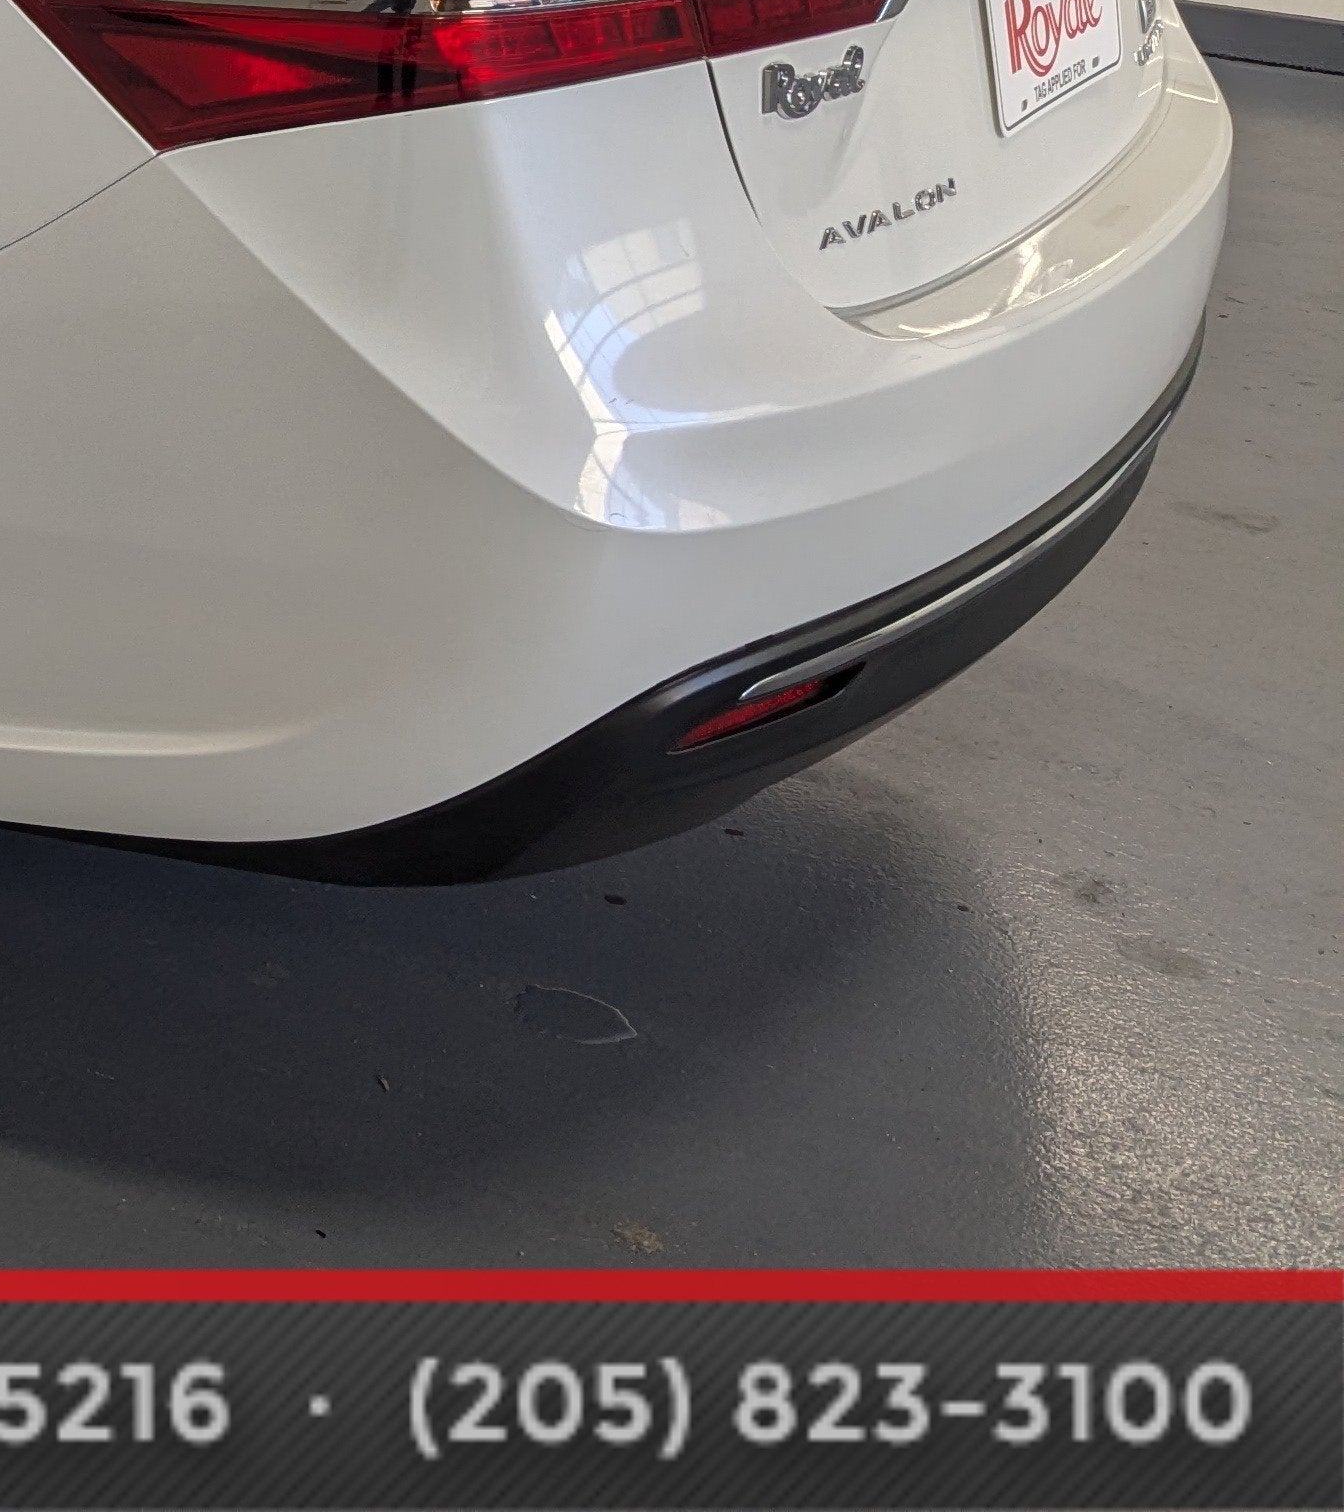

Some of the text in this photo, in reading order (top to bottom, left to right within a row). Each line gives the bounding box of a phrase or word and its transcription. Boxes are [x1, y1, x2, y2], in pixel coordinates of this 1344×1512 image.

[761, 44, 866, 121] Royal
[1033, 58, 1087, 102] TAG APPLIED FOR
[818, 177, 957, 251] AVALON
